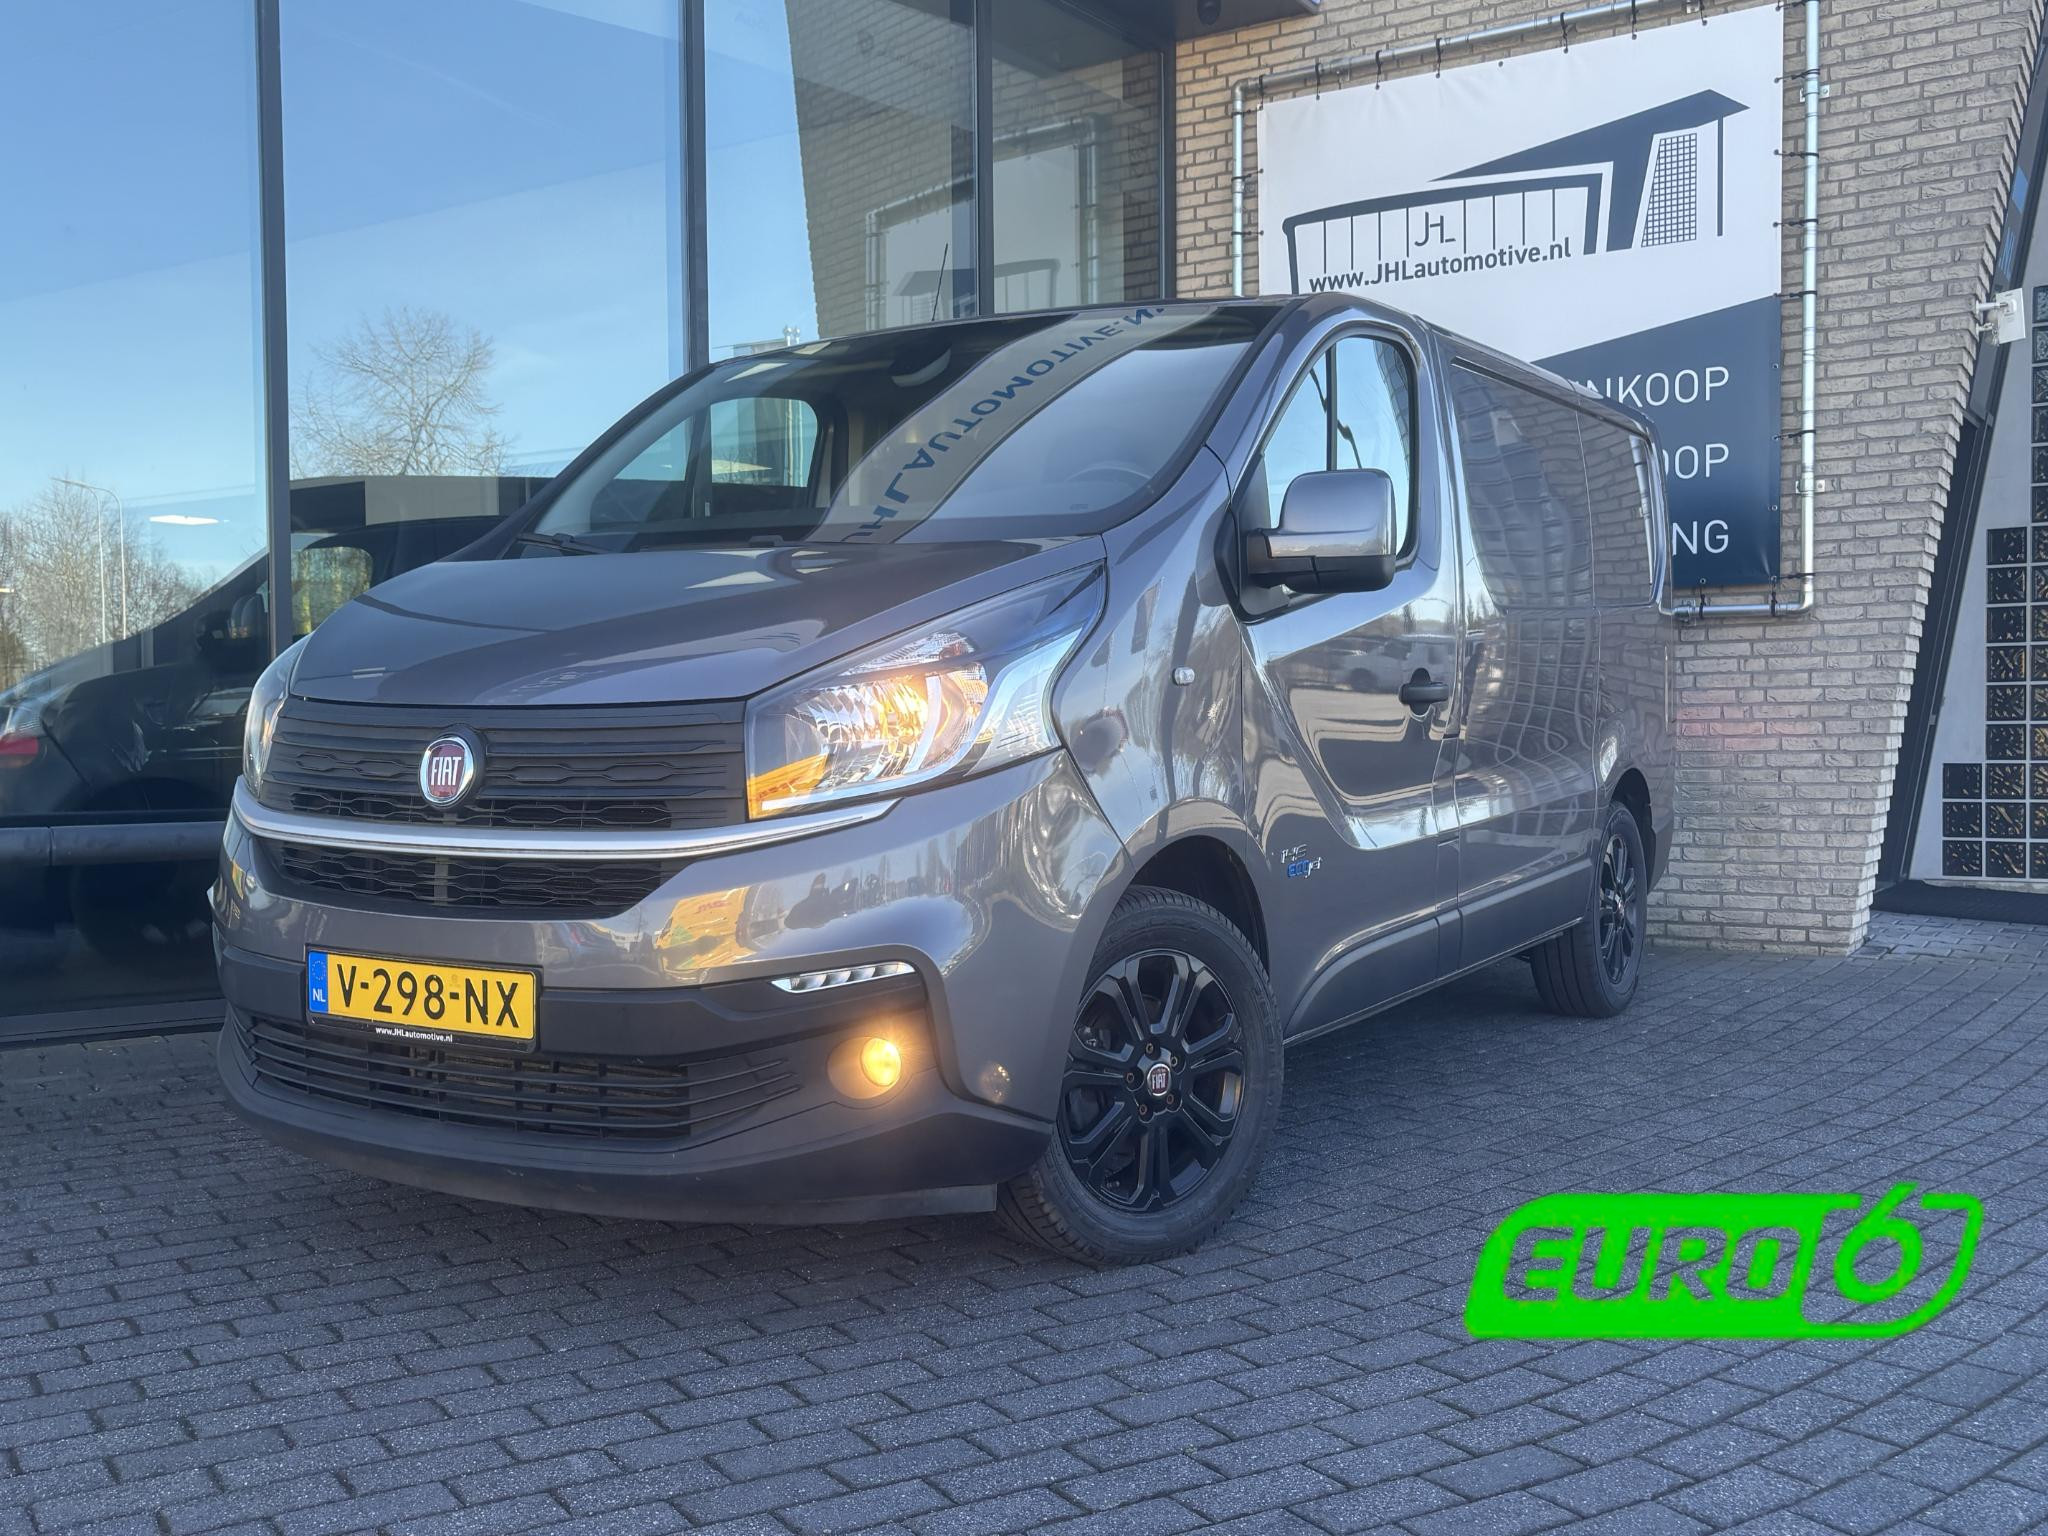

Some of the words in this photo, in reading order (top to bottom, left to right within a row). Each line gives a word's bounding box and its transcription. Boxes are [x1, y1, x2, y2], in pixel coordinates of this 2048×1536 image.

[1309, 237, 1572, 293] www.JHLautomotive.nl
[430, 756, 462, 786] FIAT
[312, 988, 327, 1003] NL
[336, 963, 520, 1029] V-298-NX
[375, 1026, 454, 1044] www.JHLautomotive.nl
[1151, 1073, 1167, 1090] FIAT
